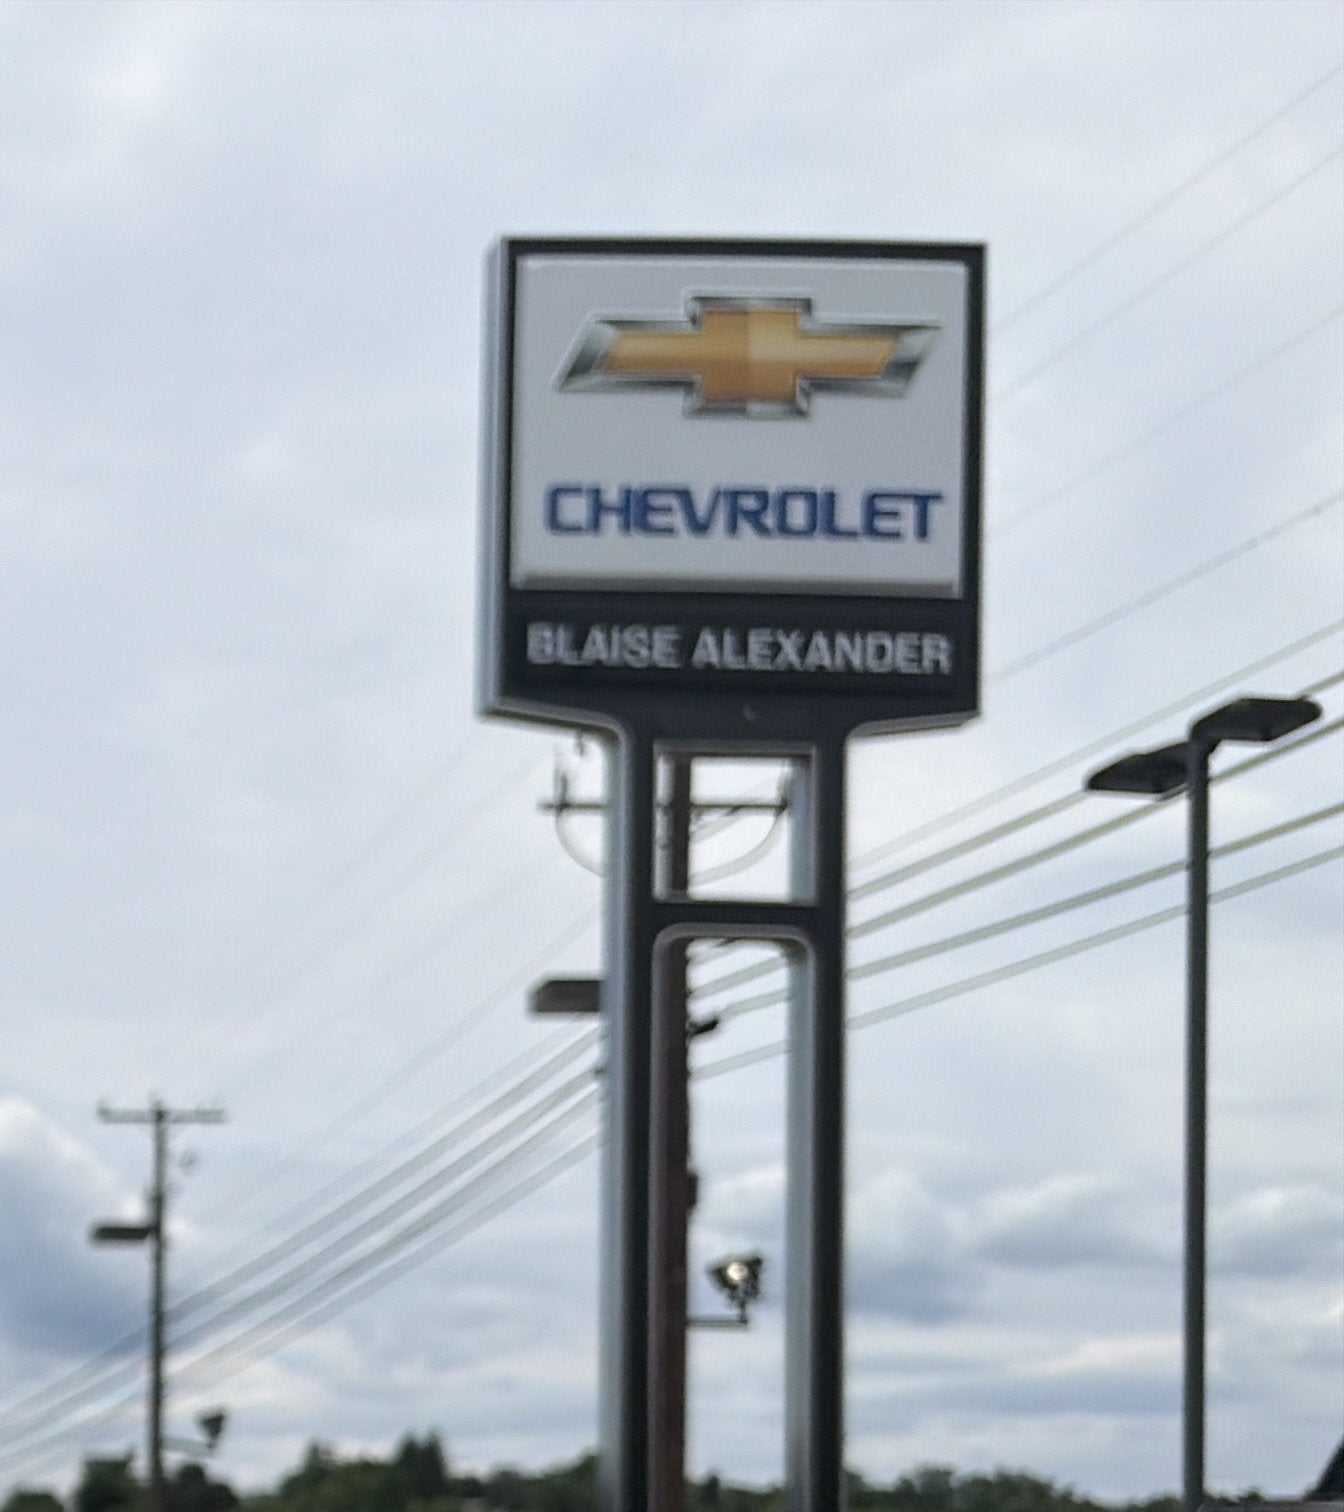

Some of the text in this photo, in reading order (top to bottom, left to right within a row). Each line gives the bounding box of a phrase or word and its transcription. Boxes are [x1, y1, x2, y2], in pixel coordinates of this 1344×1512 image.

[546, 483, 944, 541] CHEVROLET
[526, 622, 952, 675] BLAISE ALEXANDER
